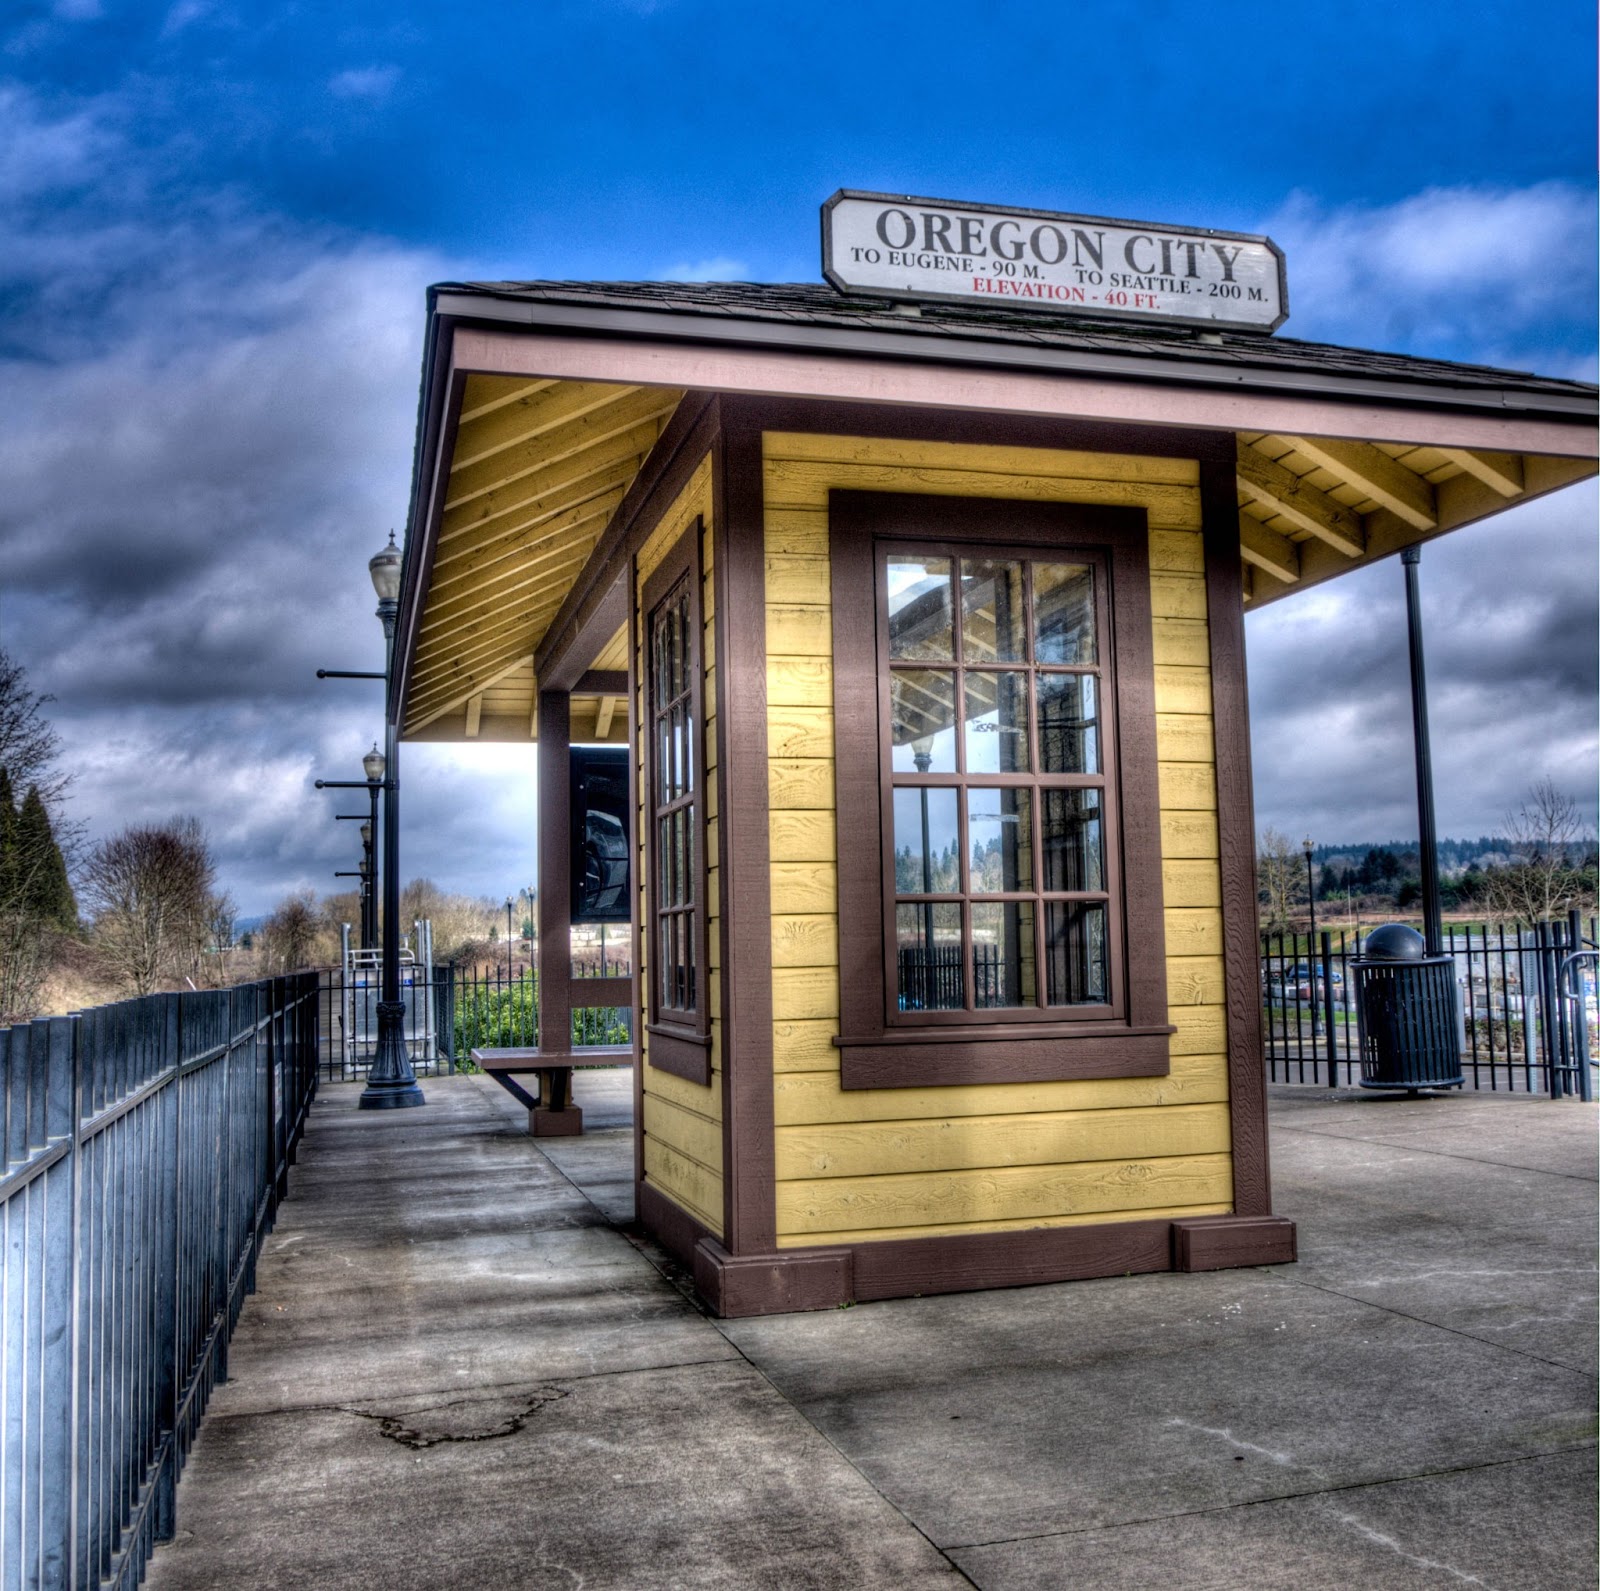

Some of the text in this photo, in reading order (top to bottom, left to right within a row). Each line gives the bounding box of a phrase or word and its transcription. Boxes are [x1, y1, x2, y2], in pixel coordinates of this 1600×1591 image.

[876, 209, 1243, 283] OREGON CITY
[851, 247, 881, 264] TO
[888, 251, 974, 272] EUGENE
[992, 261, 1016, 277] 90
[1023, 264, 1045, 280] M.
[972, 277, 1085, 303] ELEVATION
[1104, 289, 1127, 306] 40
[1134, 293, 1160, 309] FT.
[1075, 269, 1103, 286] TO
[1110, 273, 1191, 295] SEATTLE
[1208, 283, 1241, 300] 200
[1248, 287, 1269, 302] M.
